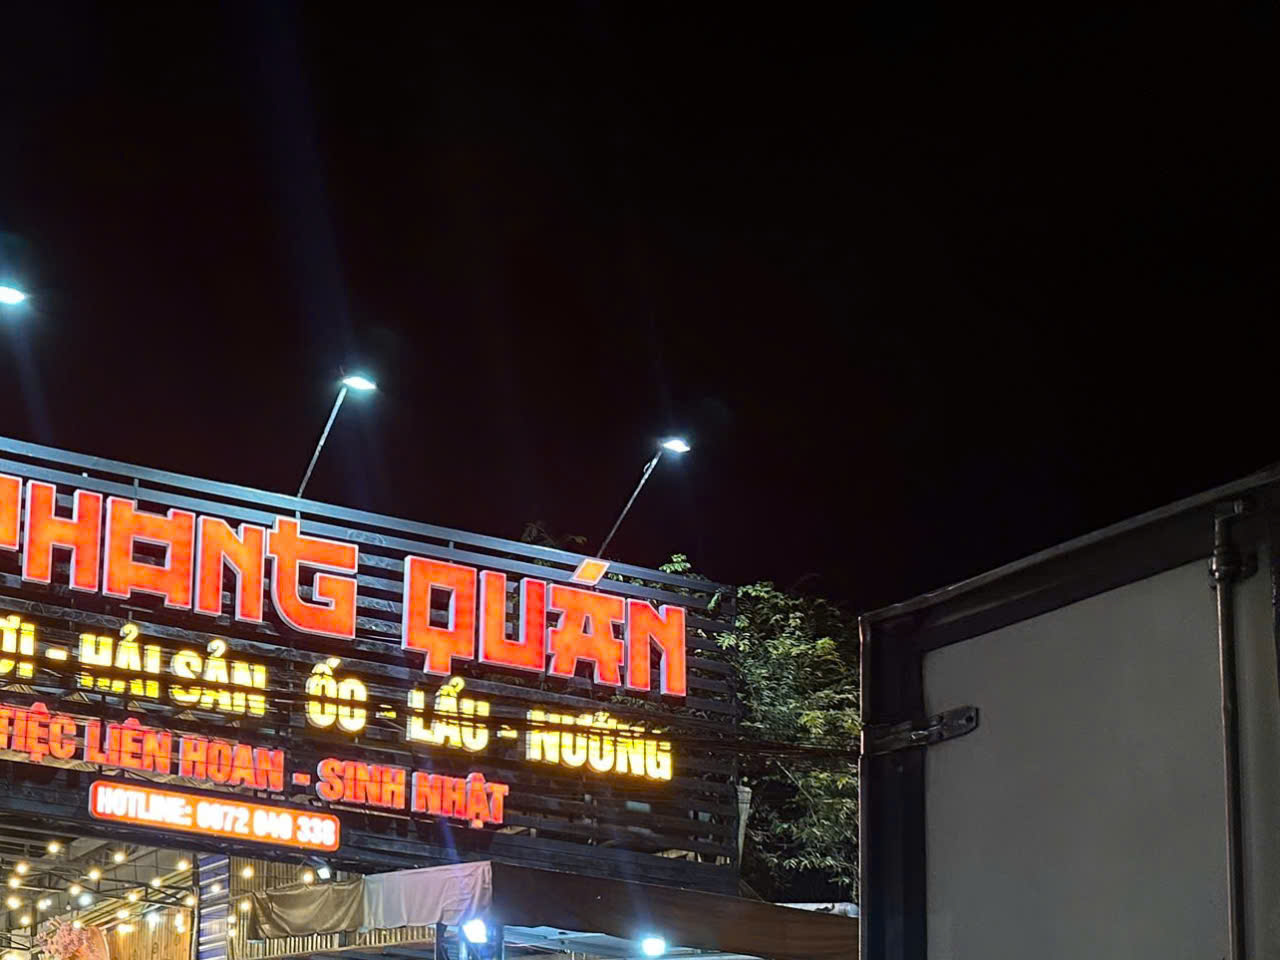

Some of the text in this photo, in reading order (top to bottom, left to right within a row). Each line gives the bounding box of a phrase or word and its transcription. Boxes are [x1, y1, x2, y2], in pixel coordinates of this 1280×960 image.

[77, 623, 161, 698] HẢI
[169, 638, 268, 716] SẢN
[305, 656, 368, 734] ỐC
[401, 557, 688, 697] QUÁN
[84, 716, 172, 776] LIÊN
[178, 733, 286, 792] HOAN
[316, 757, 408, 809] SINH
[411, 771, 510, 829] NHẬT
[97, 786, 192, 826] HOTLINE:
